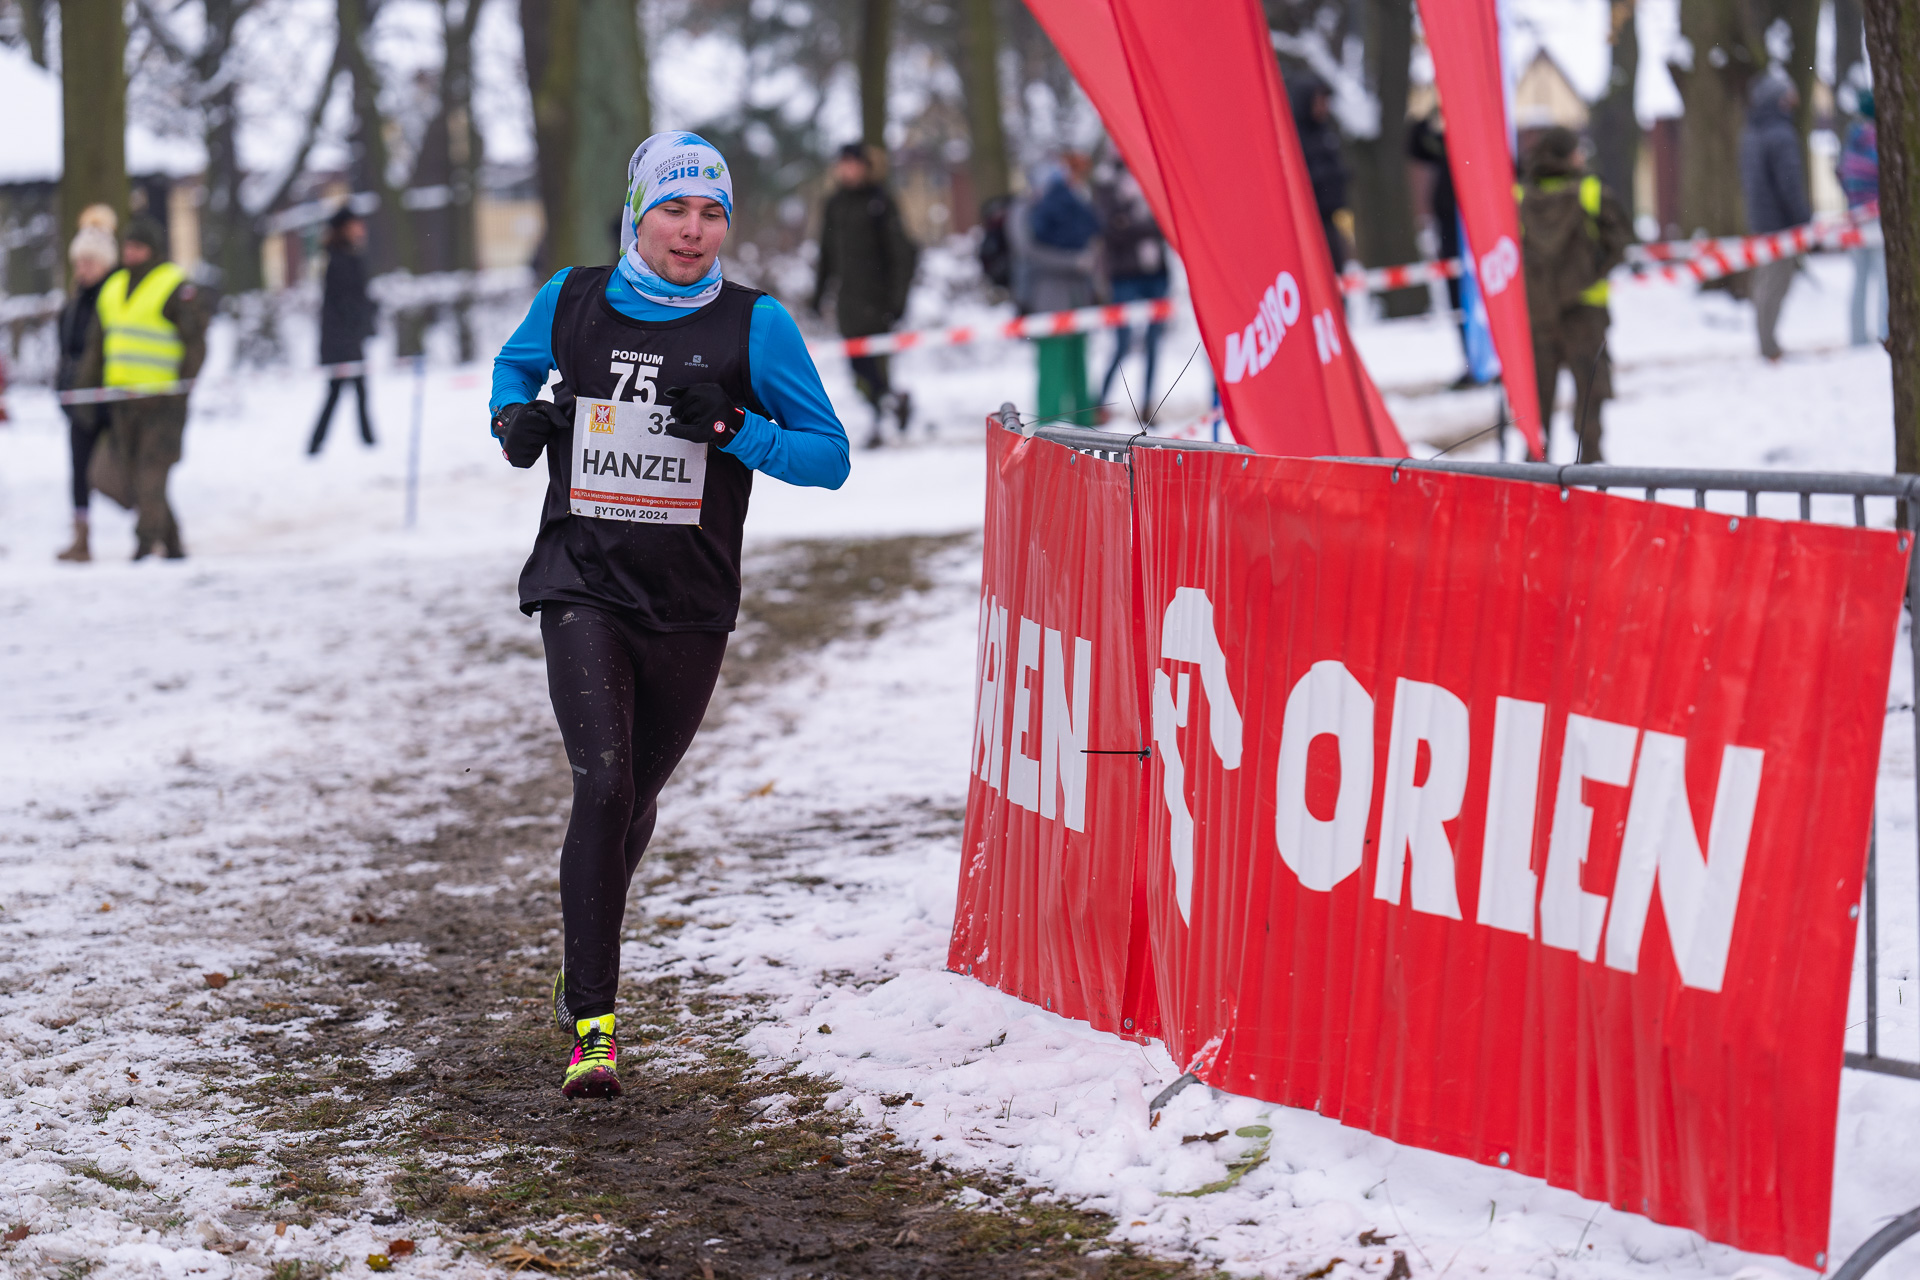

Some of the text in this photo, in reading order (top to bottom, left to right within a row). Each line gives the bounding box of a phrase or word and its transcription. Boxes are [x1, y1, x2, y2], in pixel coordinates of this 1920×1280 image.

[611, 350, 664, 365] PODIUM
[610, 361, 659, 405] 75
[590, 422, 614, 434] PZLA
[582, 448, 692, 484] HANZEL
[594, 506, 668, 521] BYTOM 2024
[972, 584, 1092, 834] RLEN
[1275, 659, 1765, 993] ORLEN
